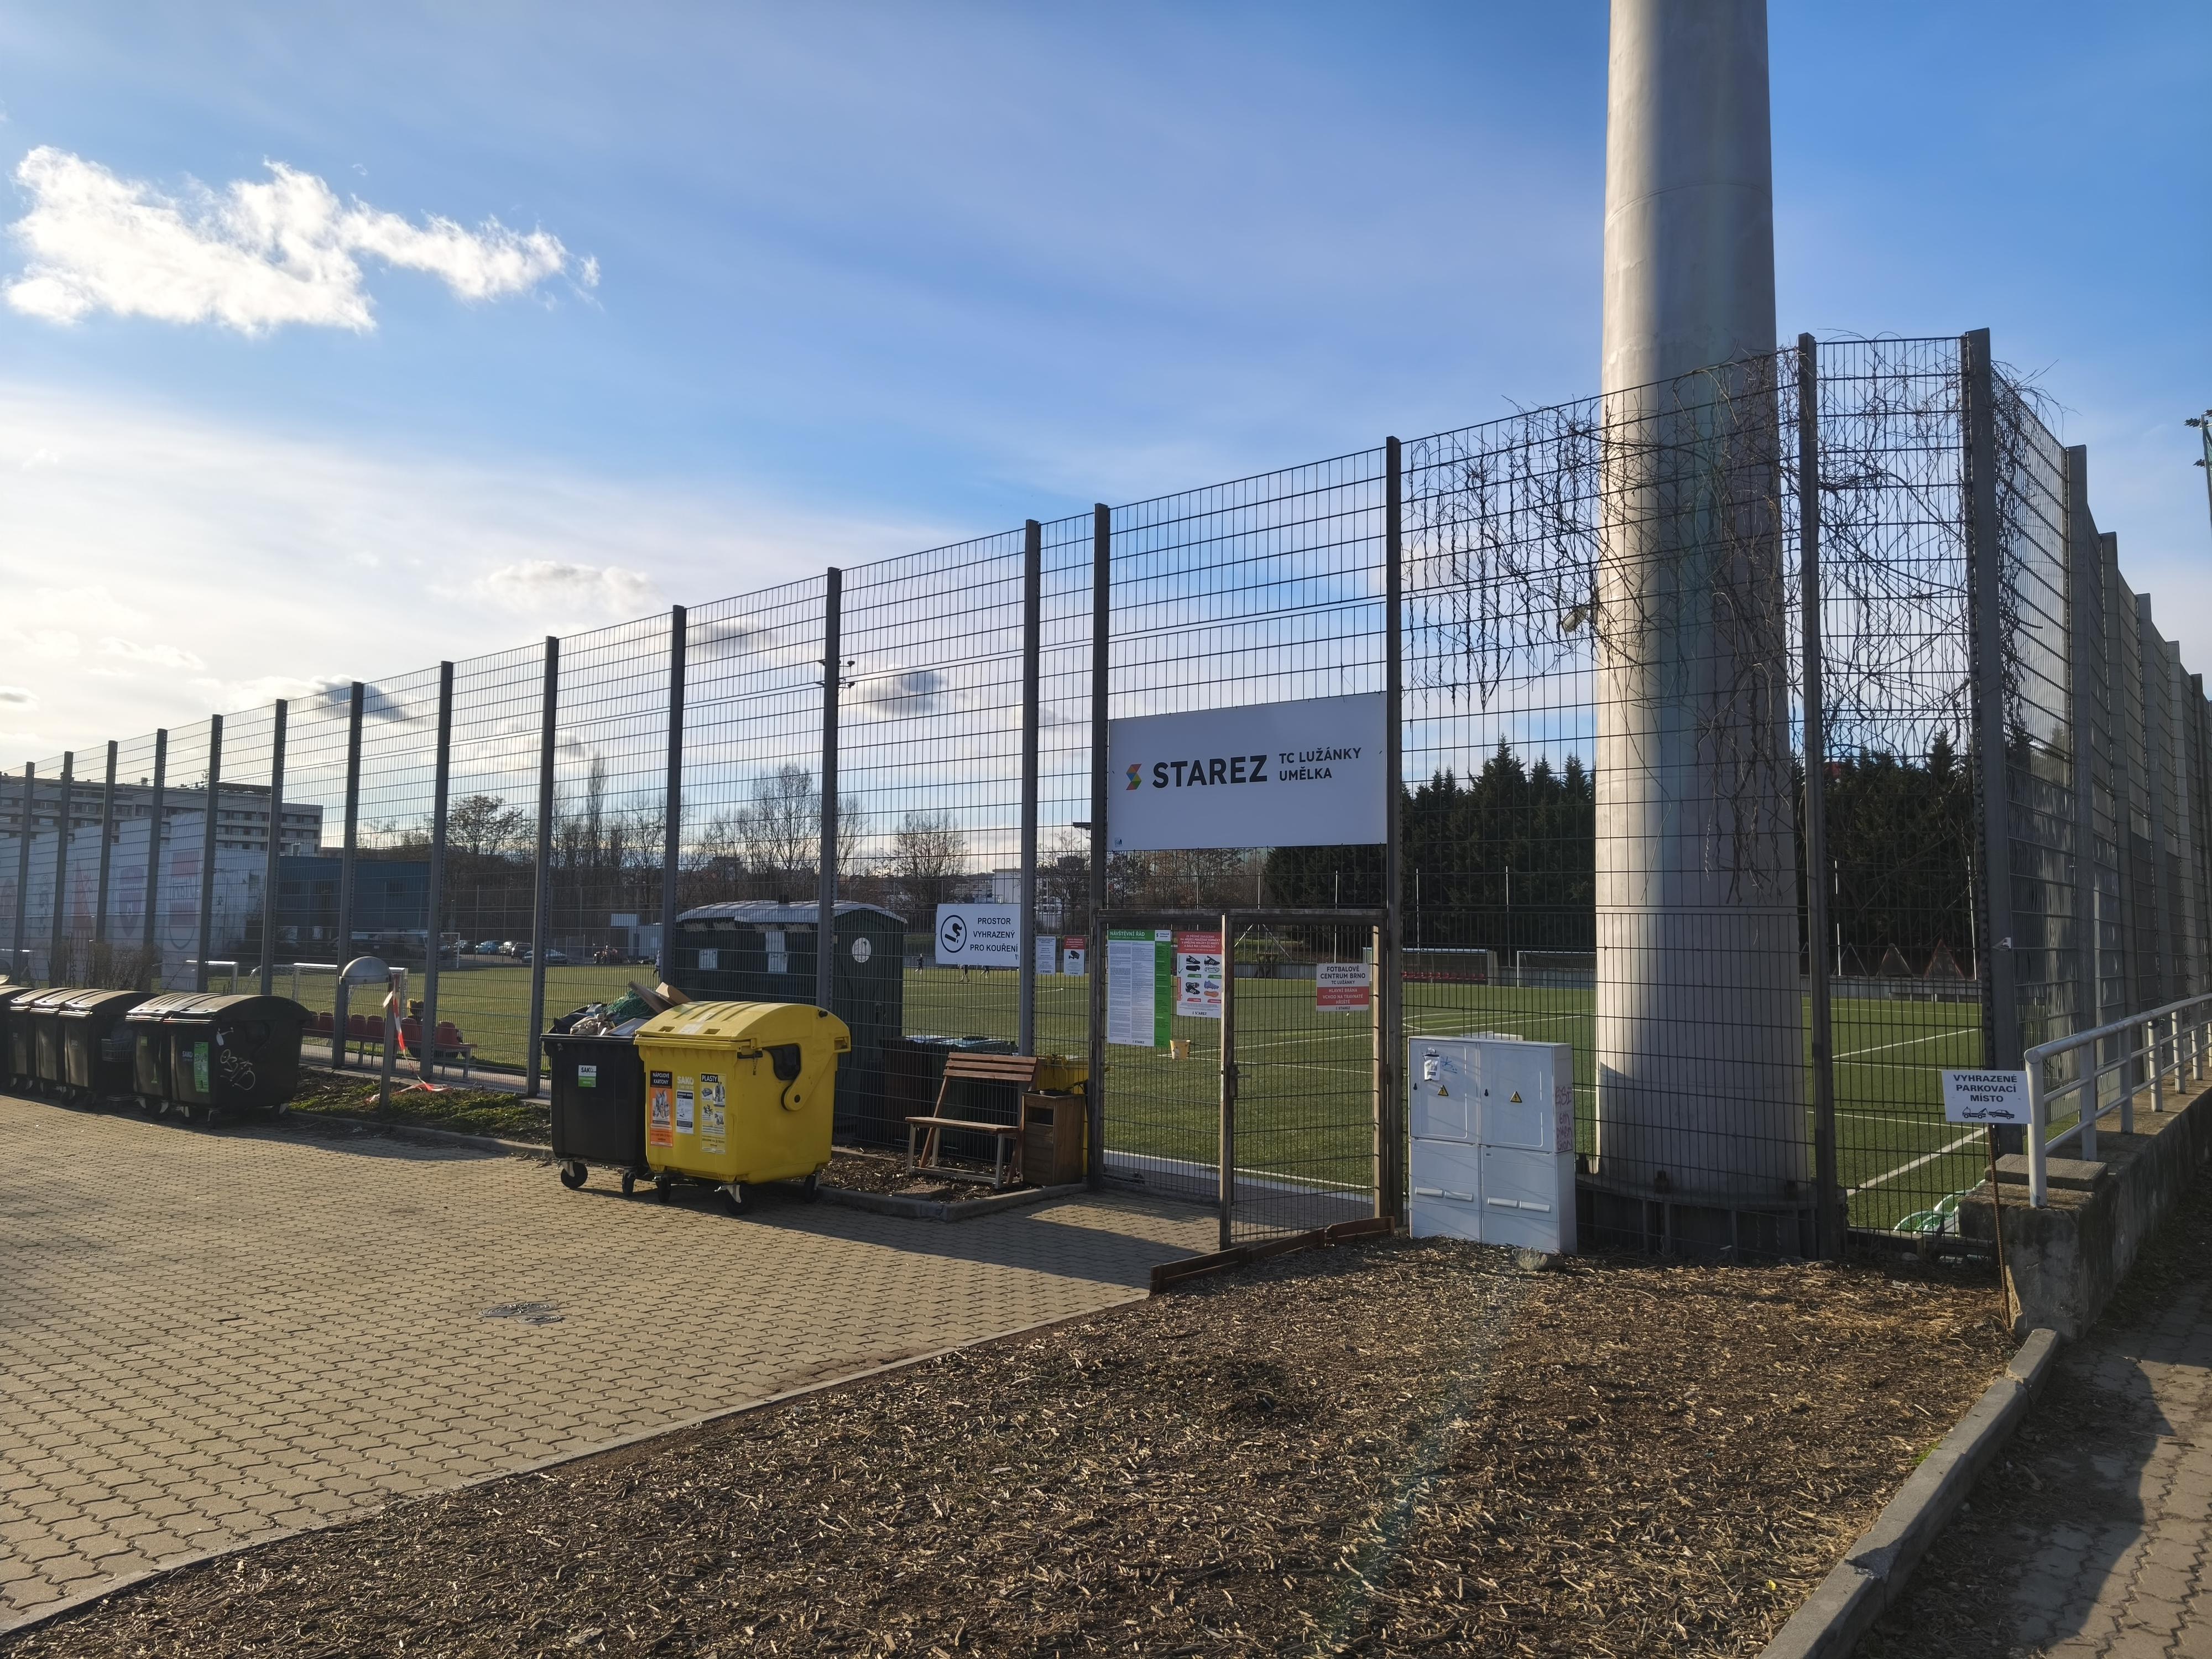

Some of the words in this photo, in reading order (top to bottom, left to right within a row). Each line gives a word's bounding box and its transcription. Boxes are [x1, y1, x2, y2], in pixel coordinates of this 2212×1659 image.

[1279, 753, 1295, 764] TC
[1299, 747, 1362, 762] LUŽÁNKY
[1152, 755, 1267, 789] STAREZ
[1279, 766, 1332, 781] UMĚLKA
[973, 930, 1015, 938] VYHRAZENÝ
[986, 943, 1018, 952] KOUŘENÍ
[677, 1076, 694, 1085] SAKO
[1953, 1074, 2017, 1083] VYHRAZENÉ
[1956, 1084, 2016, 1093] PARKOVACÍ
[1970, 1093, 2004, 1102] MÍSTO
